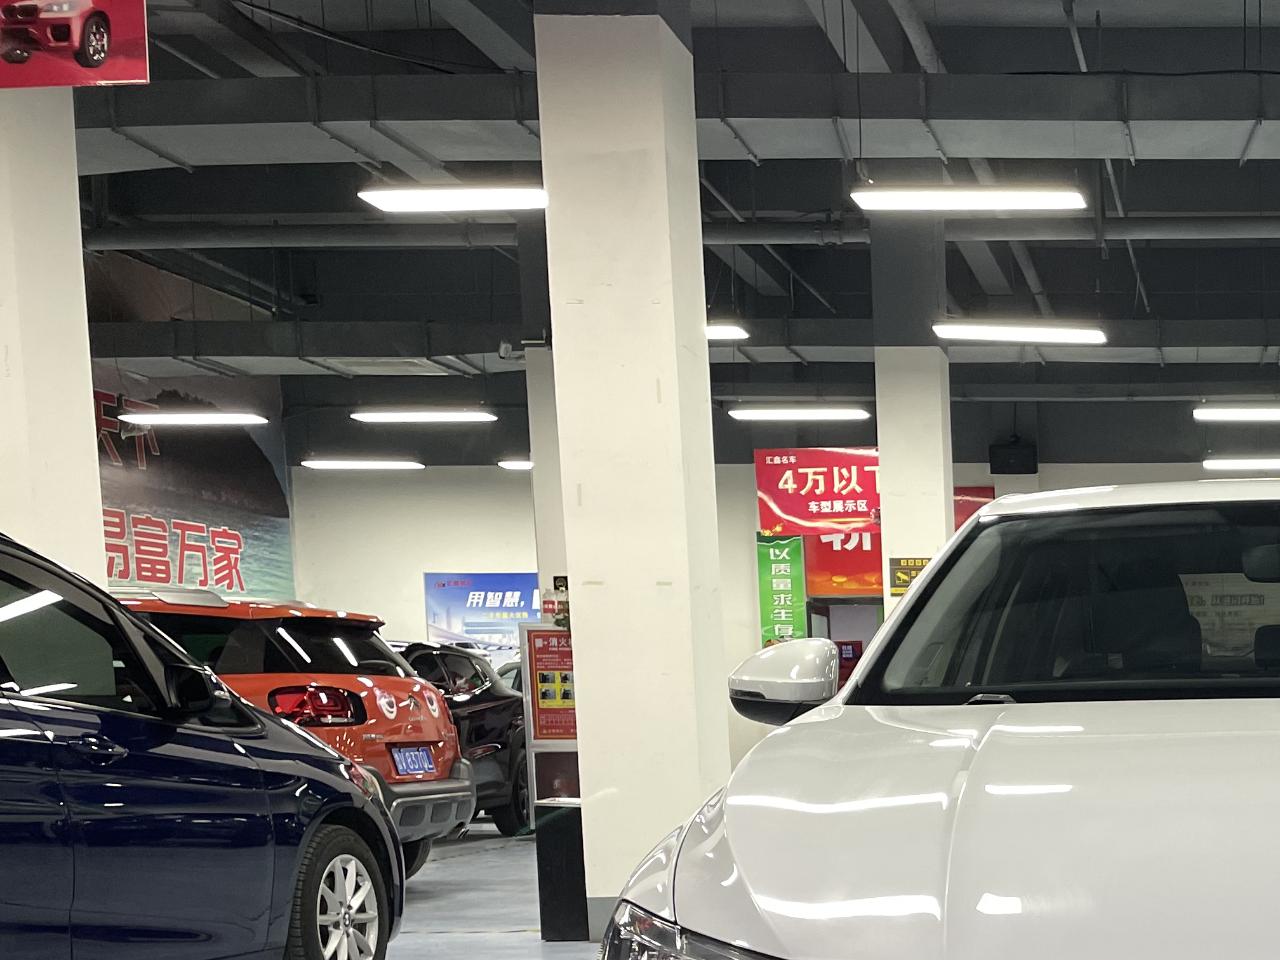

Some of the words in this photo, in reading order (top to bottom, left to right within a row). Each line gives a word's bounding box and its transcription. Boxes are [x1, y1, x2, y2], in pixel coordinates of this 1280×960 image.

[765, 455, 797, 464] 汇鑫名车
[808, 499, 869, 513] 车型展示区
[769, 547, 794, 637] 以质量求生存
